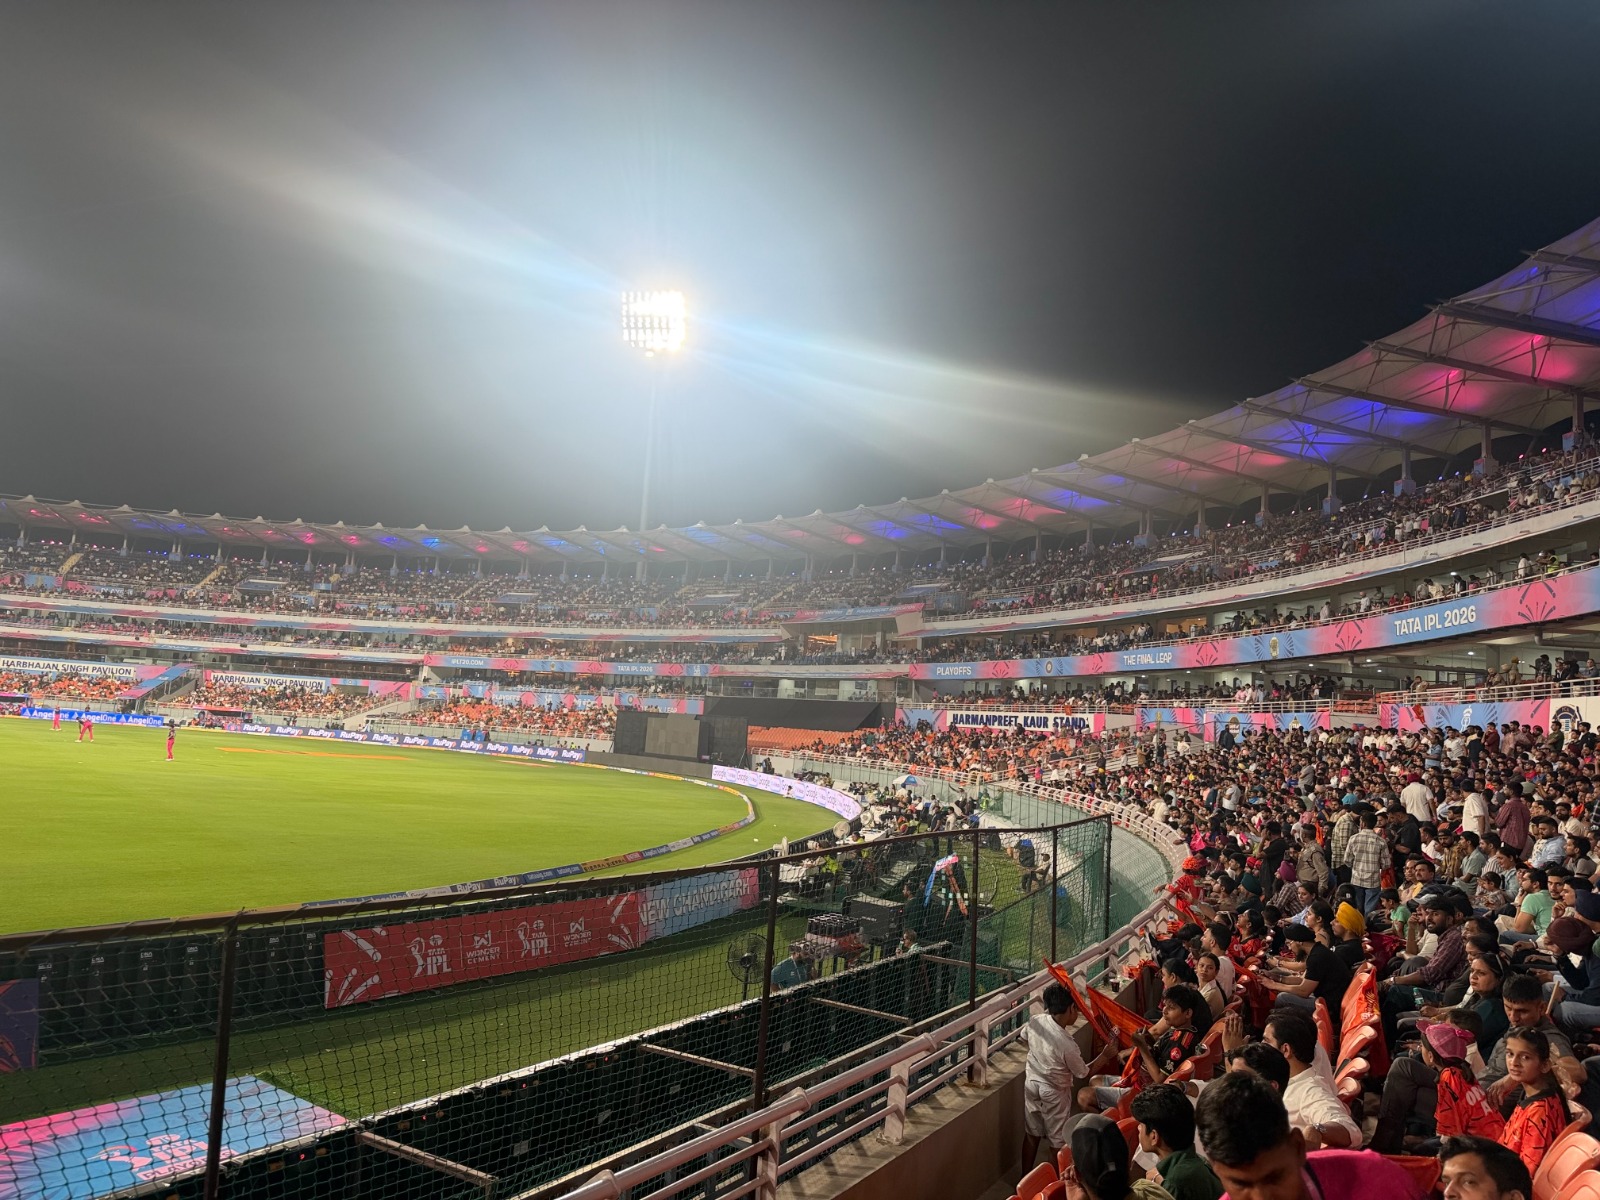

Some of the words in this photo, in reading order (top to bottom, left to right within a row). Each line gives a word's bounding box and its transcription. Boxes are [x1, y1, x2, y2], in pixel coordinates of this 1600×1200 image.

[1394, 616, 1422, 636] TATA
[1424, 613, 1442, 631] IPL
[1444, 606, 1476, 628] 2026
[1124, 655, 1136, 665] THE
[1137, 654, 1155, 664] FINAL
[1156, 652, 1172, 664] LEAP
[2, 660, 58, 670] HARBHAJAN
[62, 664, 89, 672] SINGH
[92, 666, 132, 675] PAVILION
[936, 666, 972, 676] PLAYOFFS
[213, 675, 260, 684] HARBHAJAN
[32, 711, 69, 720] Angelne
[128, 715, 162, 724] AngelOne
[953, 714, 1018, 726] HARMANPREET
[1024, 716, 1048, 728] KAUR
[1053, 717, 1086, 730] STAND
[243, 724, 267, 733] RuPay
[276, 726, 300, 736] RuPay
[308, 728, 332, 738] RuPay
[340, 731, 363, 741] RuPay
[403, 736, 426, 746] RuPay
[433, 738, 454, 748] RuPay
[460, 741, 480, 750] RuPay
[487, 743, 506, 752] RuPay
[512, 745, 531, 755] RuPay
[537, 748, 556, 758] RuPay
[562, 750, 580, 761] RuPay
[494, 876, 516, 886] RuPay
[457, 882, 481, 892] RuPay
[638, 898, 670, 926] NEW
[674, 878, 750, 916] CHANDIGARH
[563, 931, 591, 941] WONDER
[428, 948, 446, 956] TATA
[466, 946, 500, 958] WONDER
[531, 938, 552, 957] IPL
[467, 954, 500, 964] CEMENT
[426, 955, 452, 976] IPL
[143, 1151, 233, 1178] PLAYOS
